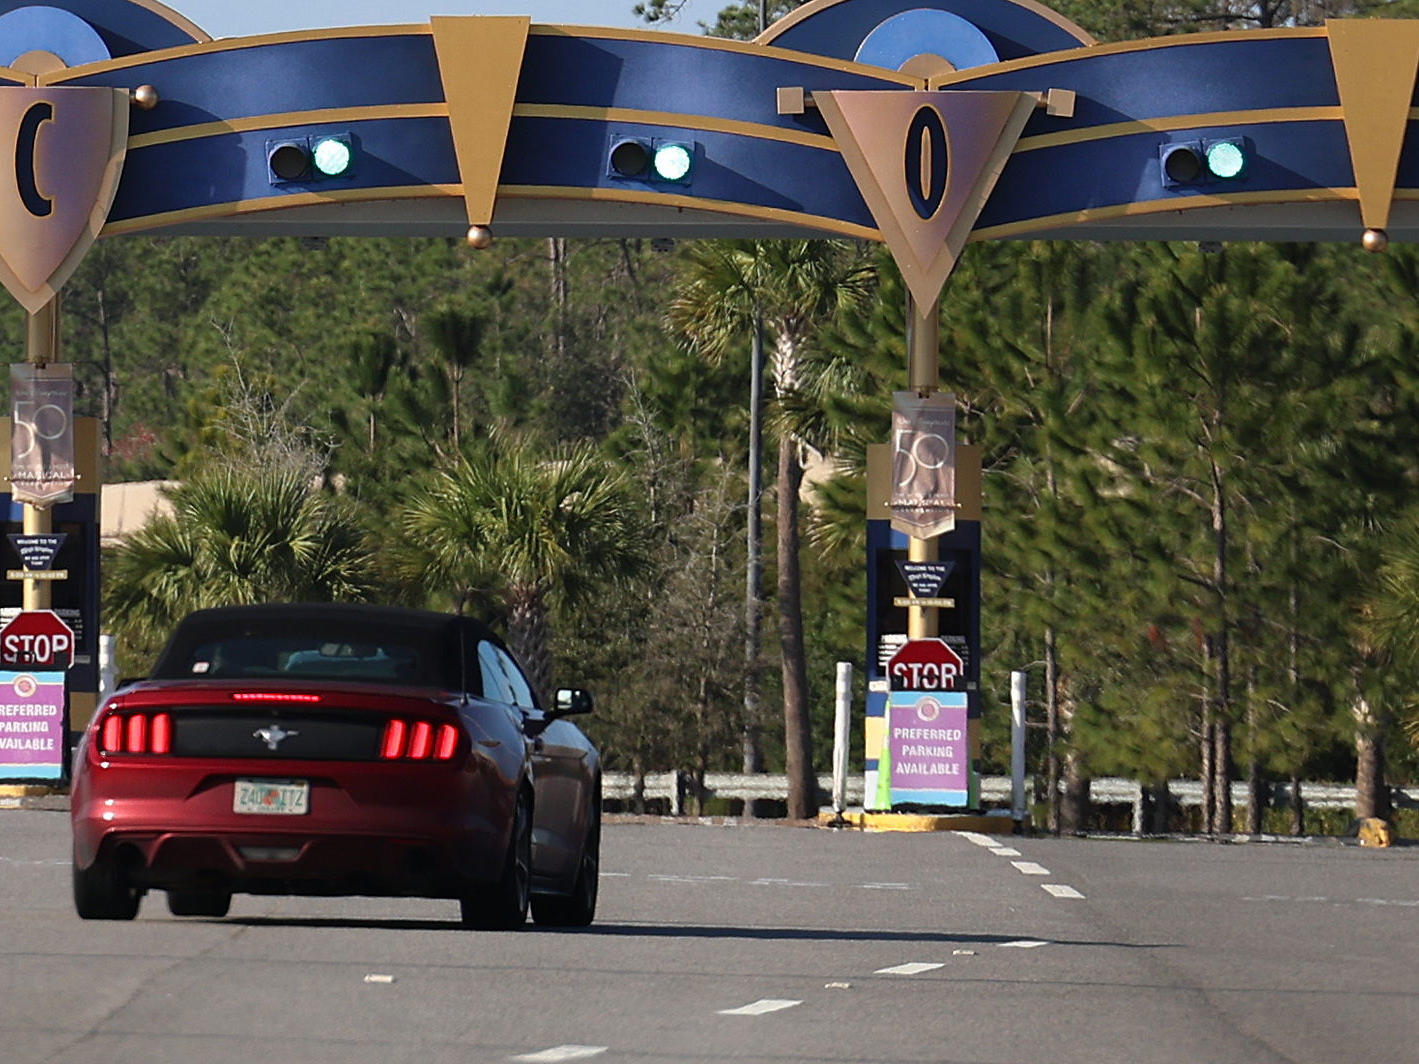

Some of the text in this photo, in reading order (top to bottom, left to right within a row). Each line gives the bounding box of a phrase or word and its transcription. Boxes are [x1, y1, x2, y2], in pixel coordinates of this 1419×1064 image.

[15, 100, 55, 218] C
[14, 400, 67, 459] 50
[895, 429, 950, 487] 50
[4, 634, 69, 663] STOP
[893, 727, 962, 741] PREFERRED
[901, 745, 954, 759] PARKING
[895, 762, 960, 775] AVAILABLE
